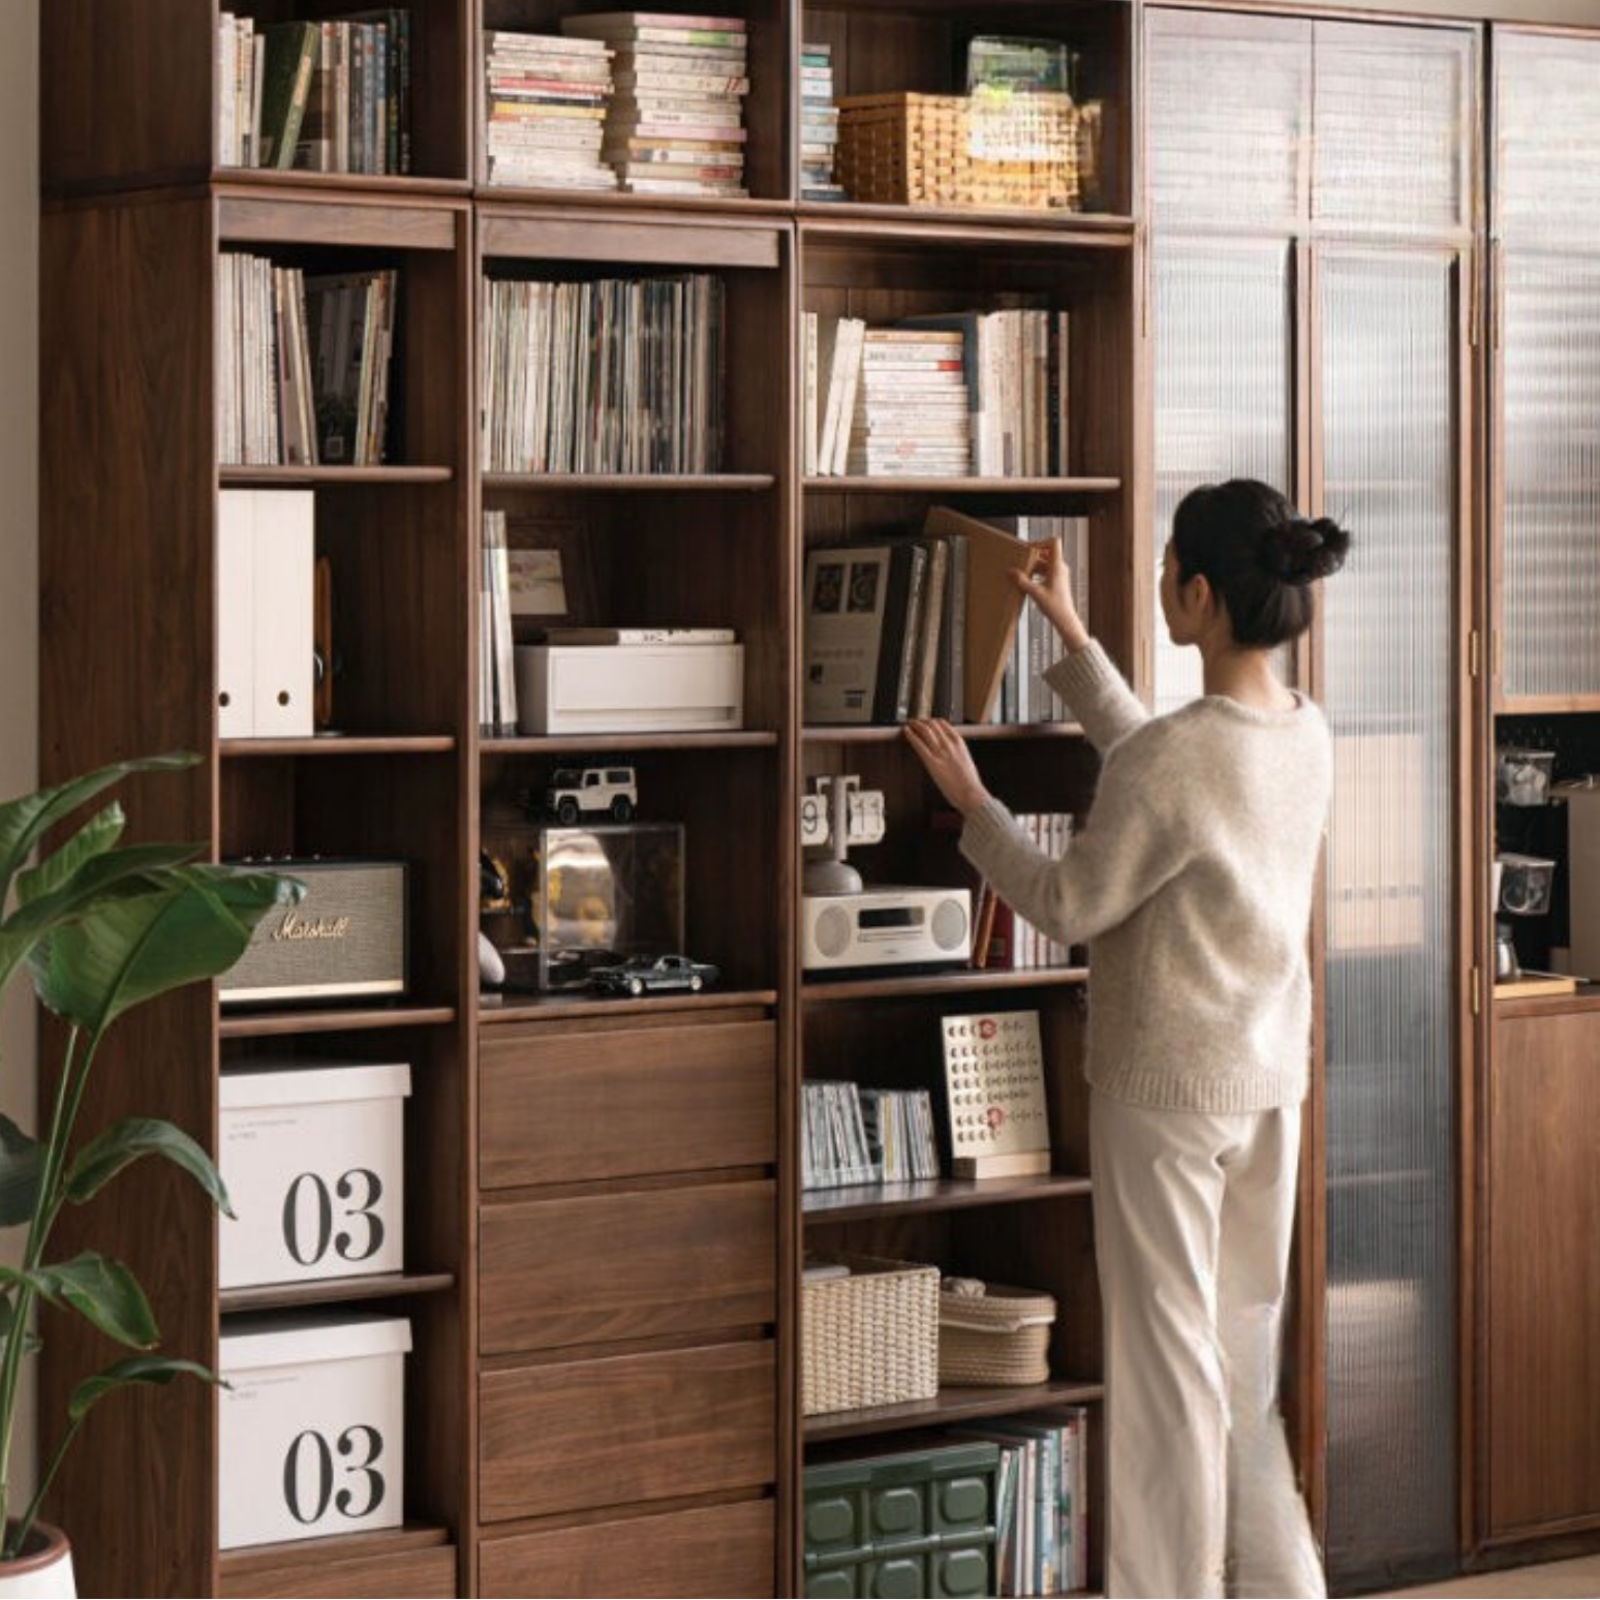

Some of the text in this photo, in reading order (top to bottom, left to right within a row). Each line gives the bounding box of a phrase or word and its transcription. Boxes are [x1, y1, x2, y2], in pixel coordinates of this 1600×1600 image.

[803, 800, 818, 834] 9
[270, 912, 349, 941] Marshall
[283, 1167, 385, 1266] 03
[283, 1424, 386, 1524] 03
